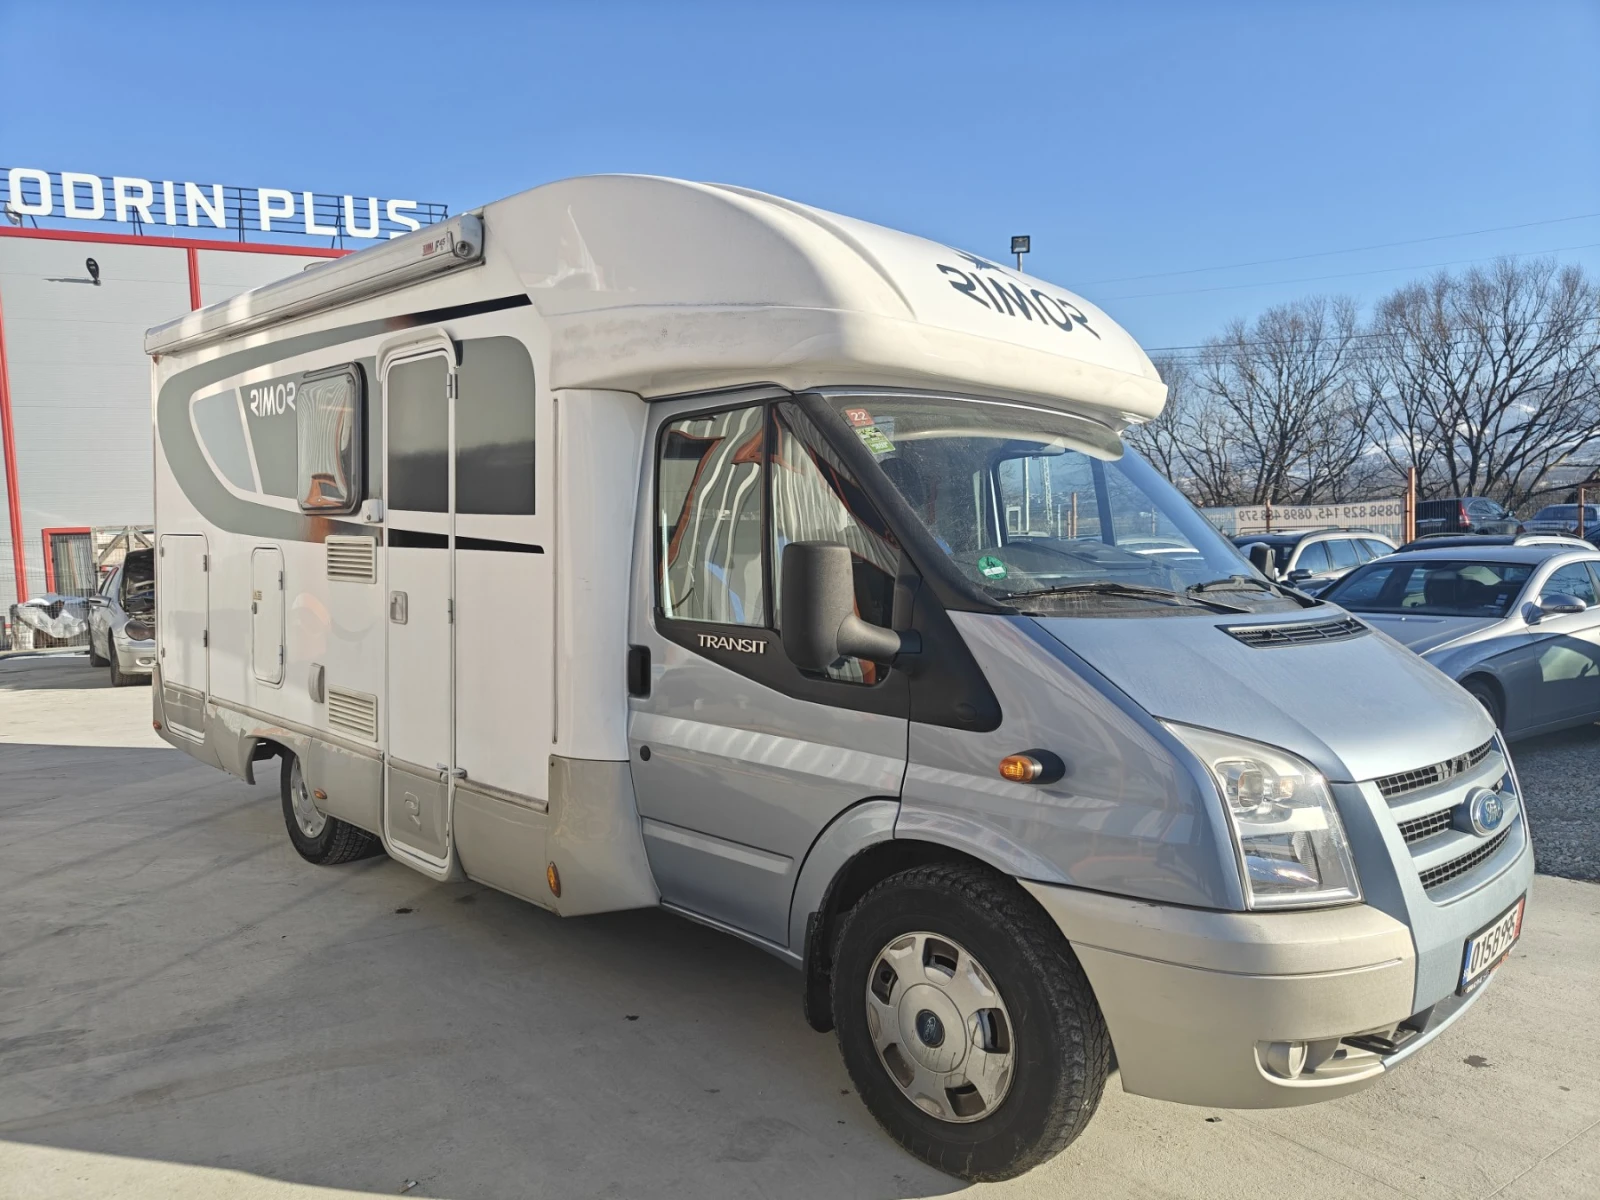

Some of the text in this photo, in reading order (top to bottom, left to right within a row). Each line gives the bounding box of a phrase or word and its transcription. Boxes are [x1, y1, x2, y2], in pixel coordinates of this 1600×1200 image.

[9, 168, 421, 239] ODRIN PLUS
[936, 263, 1101, 340] RIMOR
[250, 381, 296, 417] RIMOR
[850, 411, 868, 421] 22
[697, 633, 768, 655] TRANSIT
